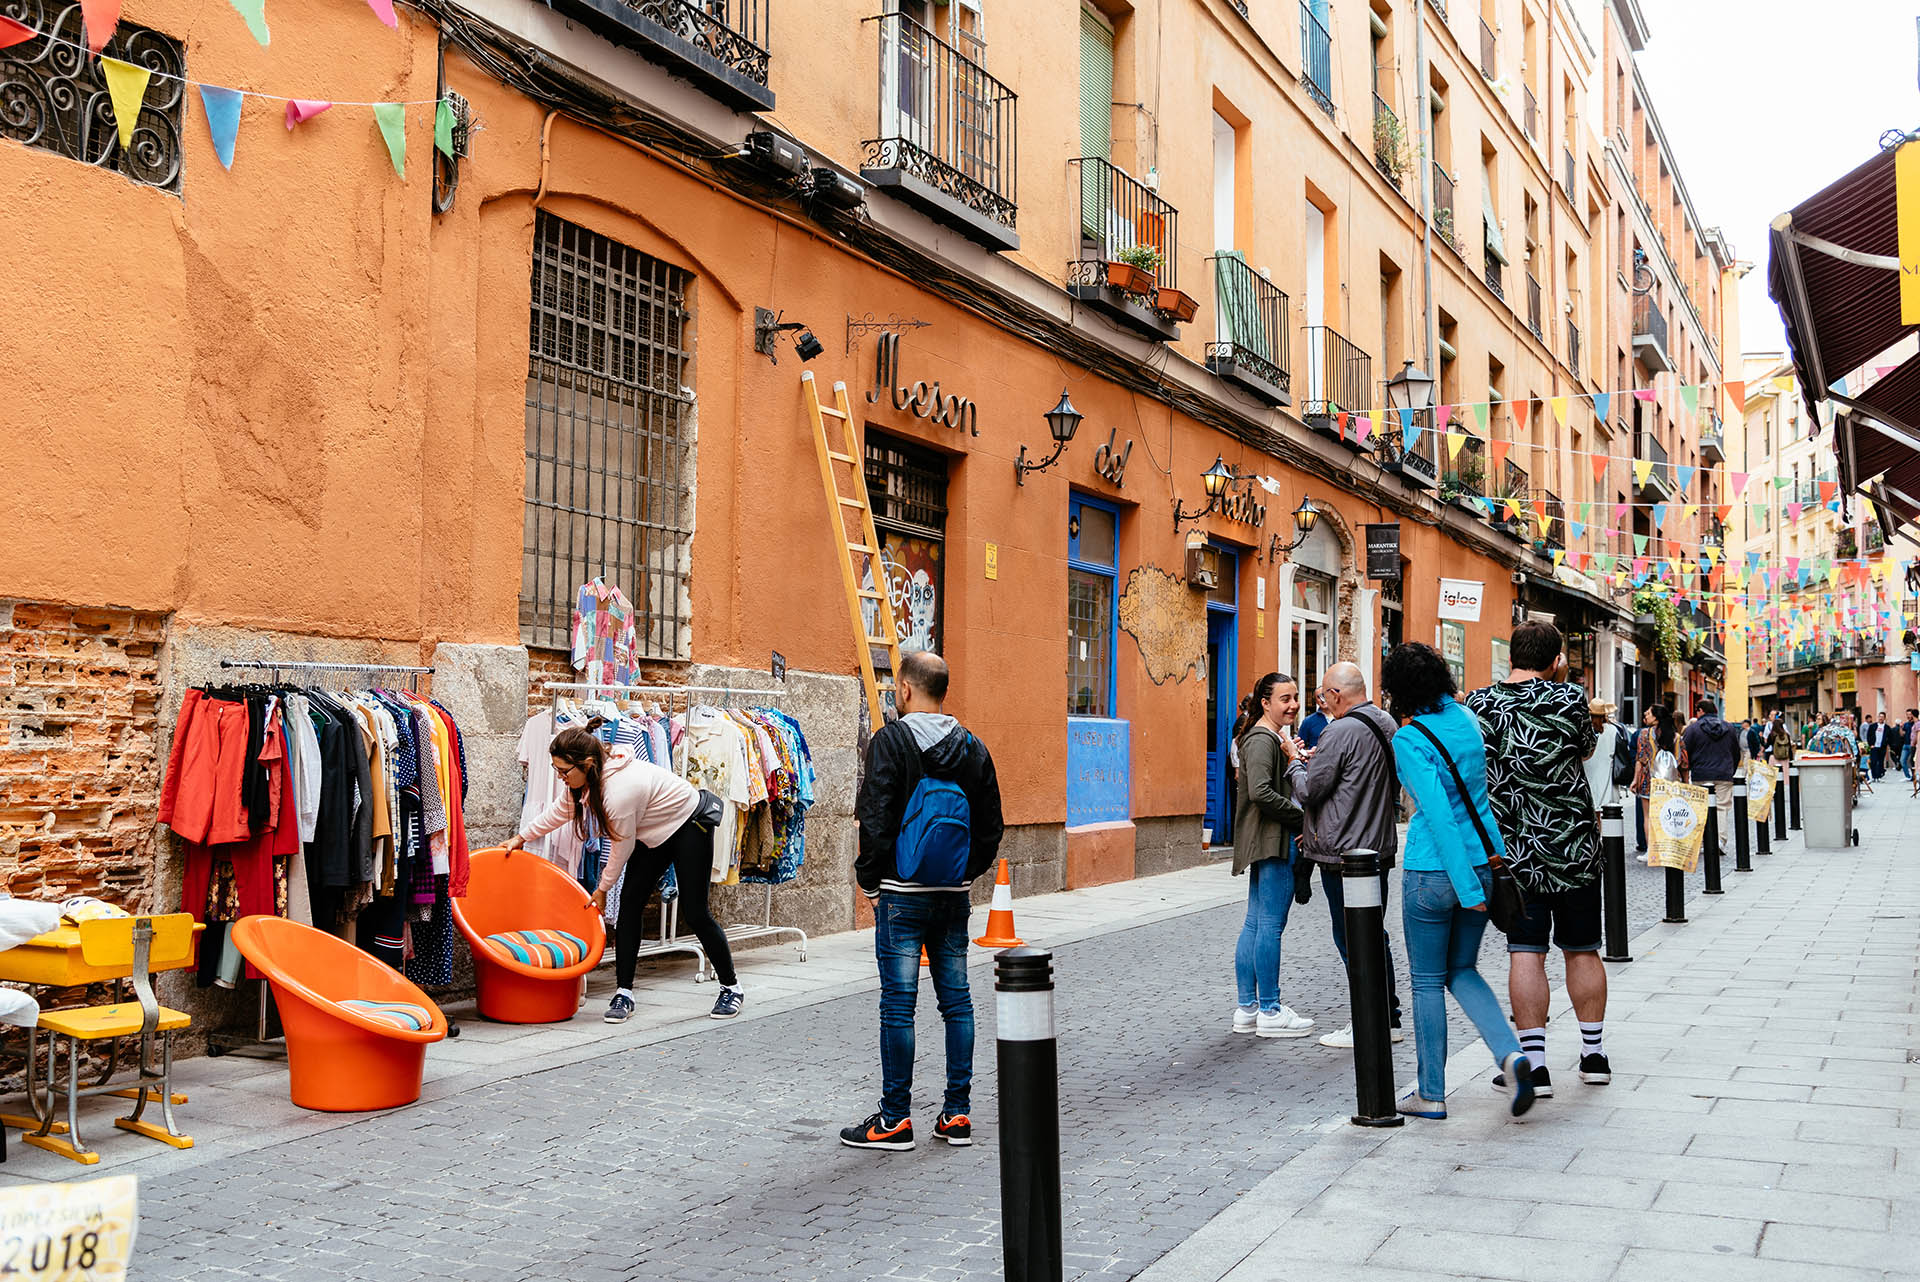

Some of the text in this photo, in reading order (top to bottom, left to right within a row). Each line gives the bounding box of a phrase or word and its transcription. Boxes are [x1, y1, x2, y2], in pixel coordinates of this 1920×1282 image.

[1095, 427, 1132, 488] del
[1444, 591, 1477, 606] igloo
[1666, 808, 1689, 820] Santa
[1, 1231, 99, 1273] 2018
